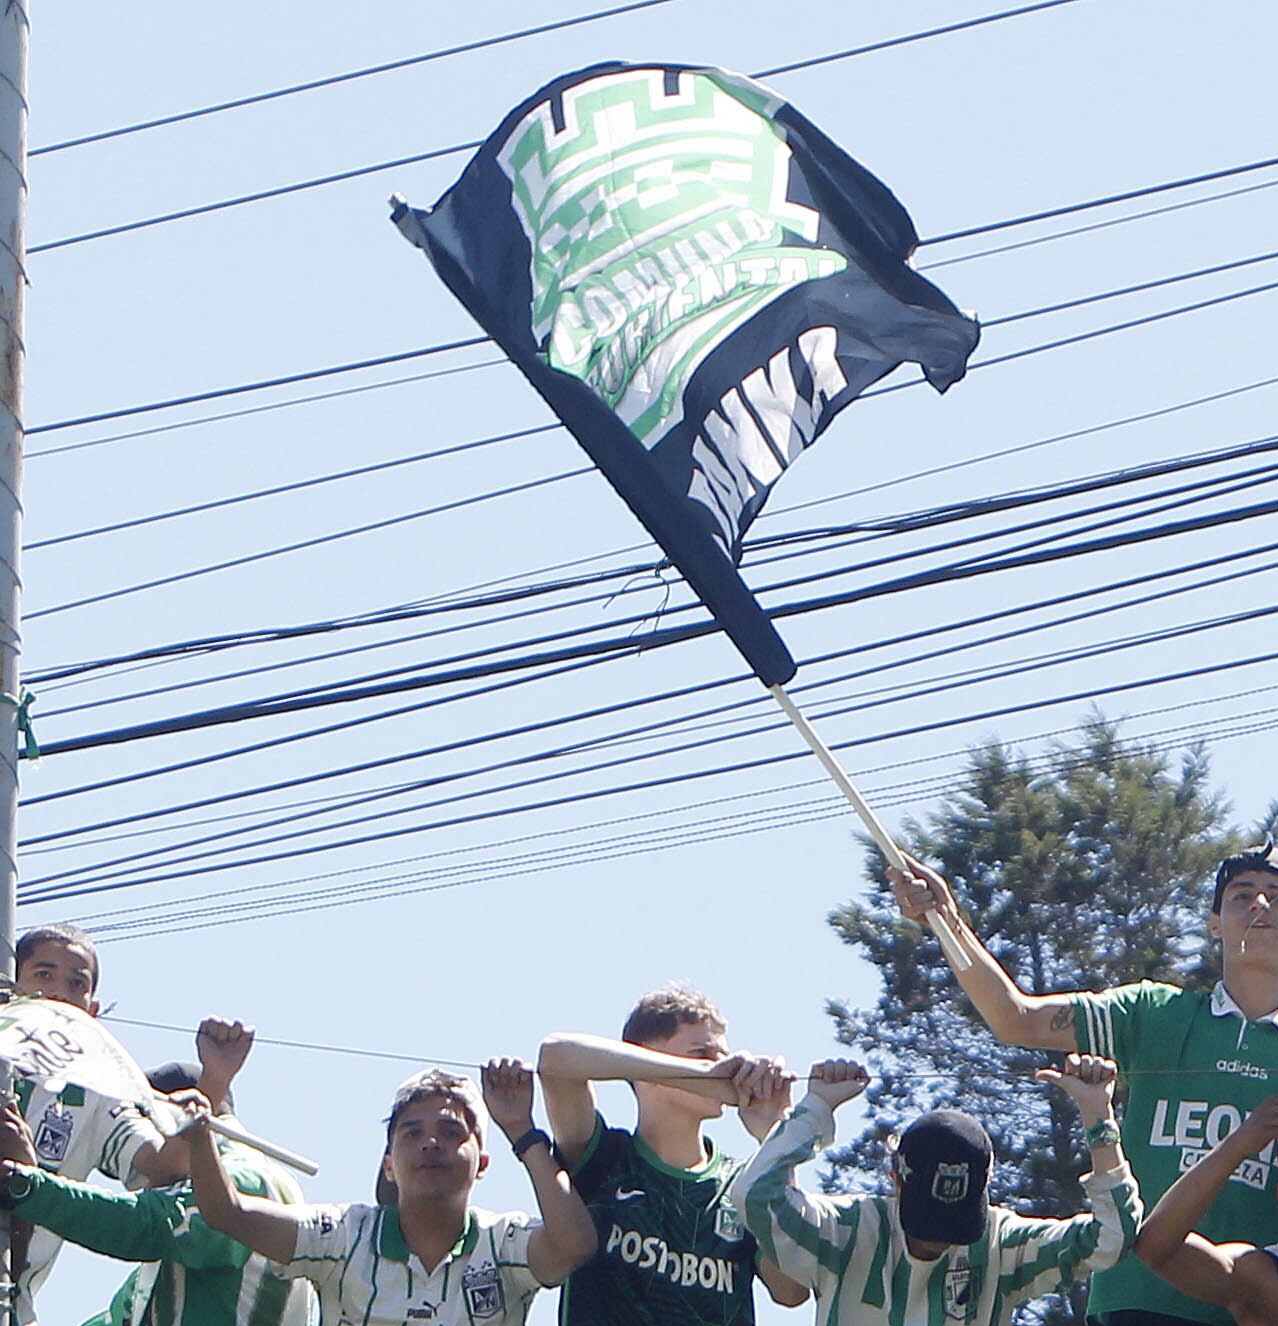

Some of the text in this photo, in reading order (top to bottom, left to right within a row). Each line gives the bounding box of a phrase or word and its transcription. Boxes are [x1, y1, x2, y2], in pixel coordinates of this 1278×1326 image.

[552, 209, 775, 365] COMUNA
[1216, 1058, 1269, 1080] adidas
[606, 1223, 735, 1294] POSTOBON
